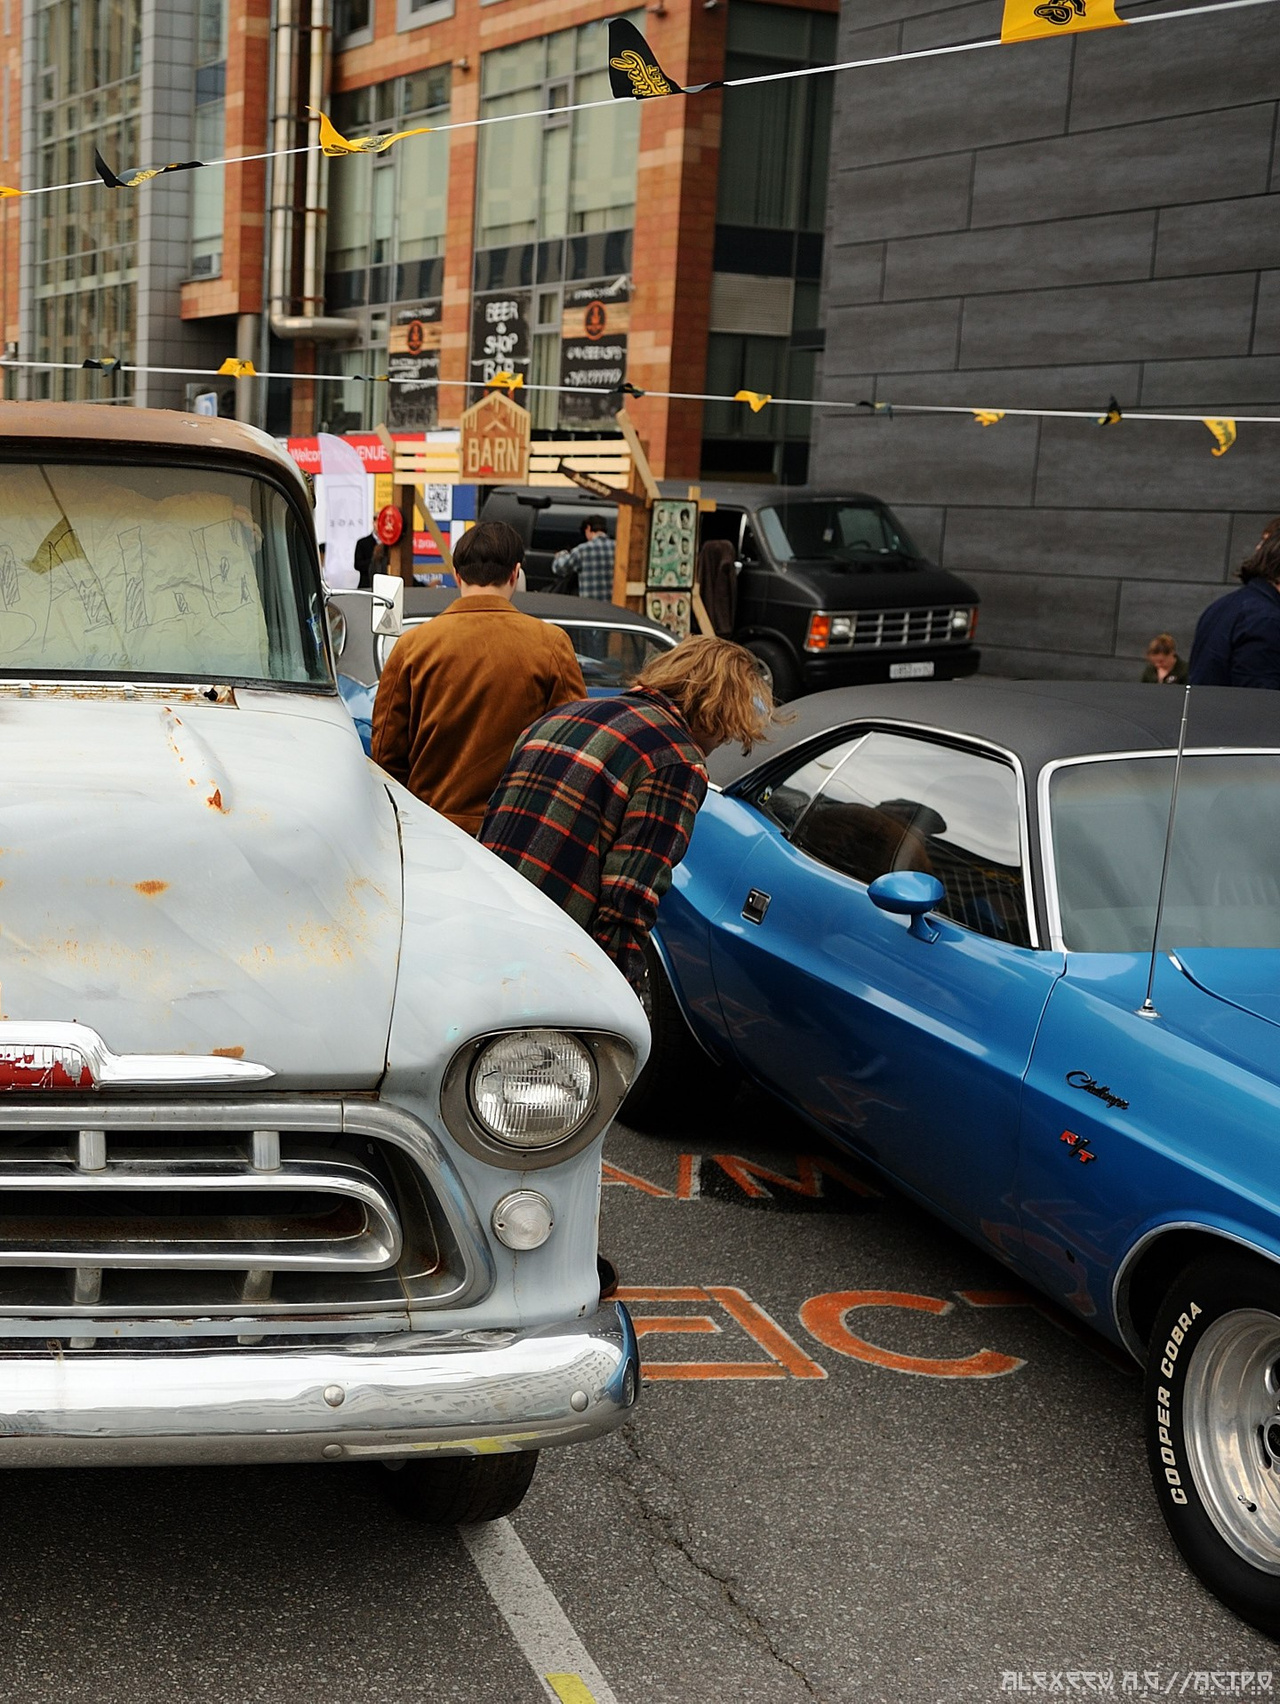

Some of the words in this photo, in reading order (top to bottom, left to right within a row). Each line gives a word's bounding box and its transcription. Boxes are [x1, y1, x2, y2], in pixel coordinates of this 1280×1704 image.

[485, 301, 519, 323] BEER
[483, 332, 518, 355] SHOP
[290, 447, 321, 461] Welco
[467, 437, 519, 473] BARN
[1066, 1070, 1130, 1110] Challenger
[1060, 1129, 1097, 1164] R/T
[1161, 1302, 1202, 1378] COBRA
[1157, 1386, 1188, 1504] COOPER
